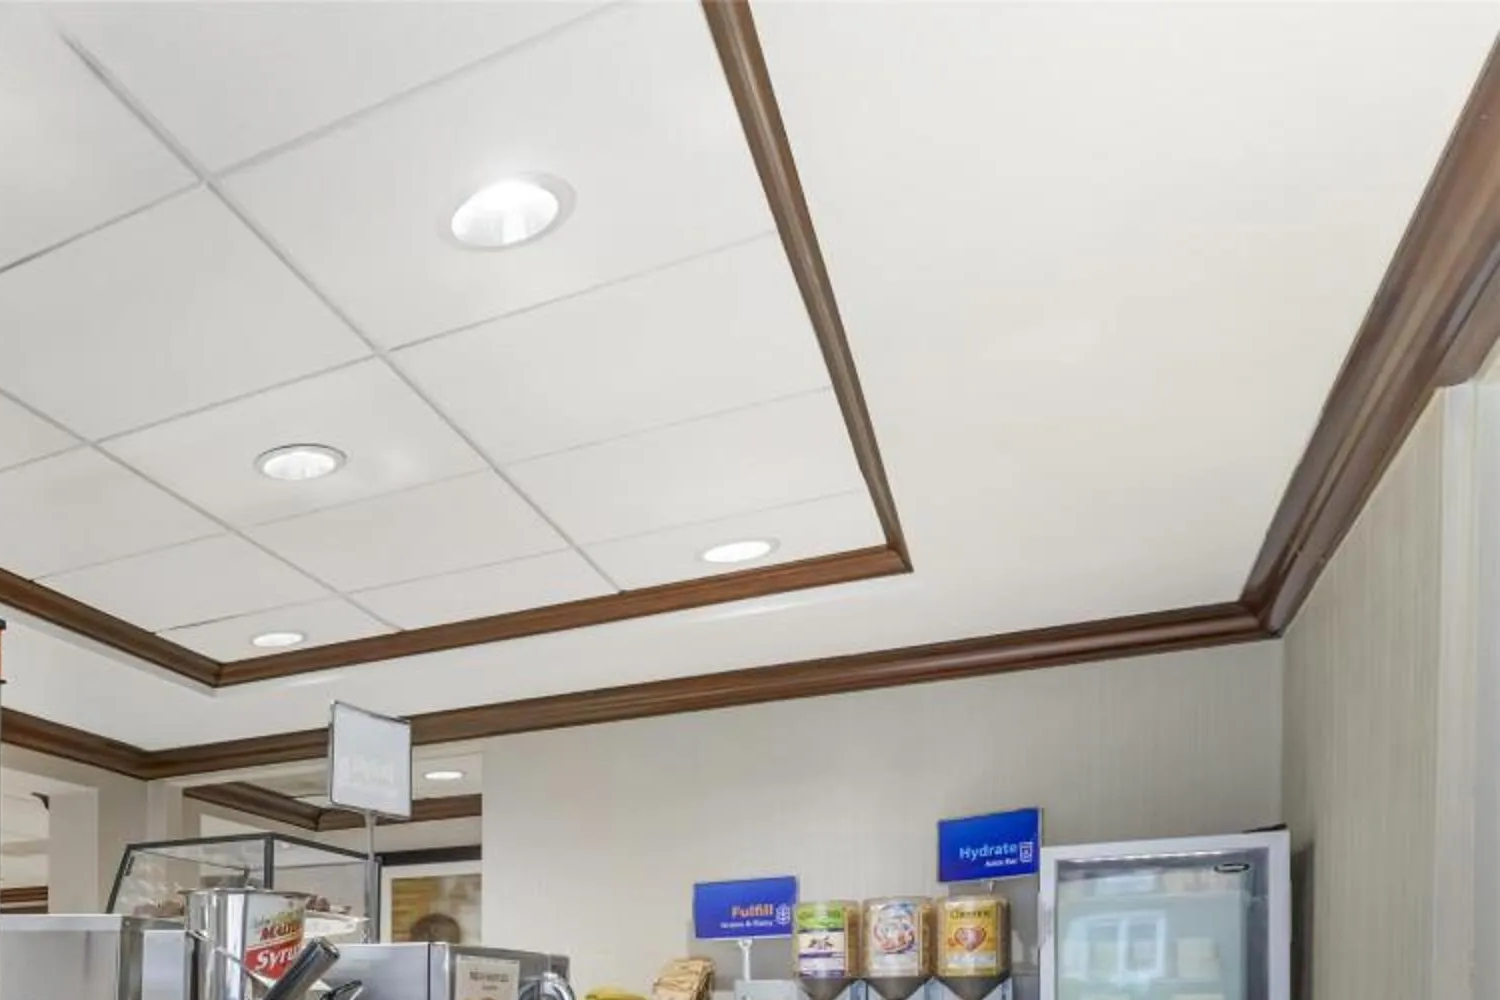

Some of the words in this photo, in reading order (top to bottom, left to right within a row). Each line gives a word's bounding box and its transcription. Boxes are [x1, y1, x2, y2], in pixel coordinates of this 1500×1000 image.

[959, 842, 1018, 862] Hydrate
[731, 903, 773, 919] Fulfill
[255, 943, 301, 971] Syru
